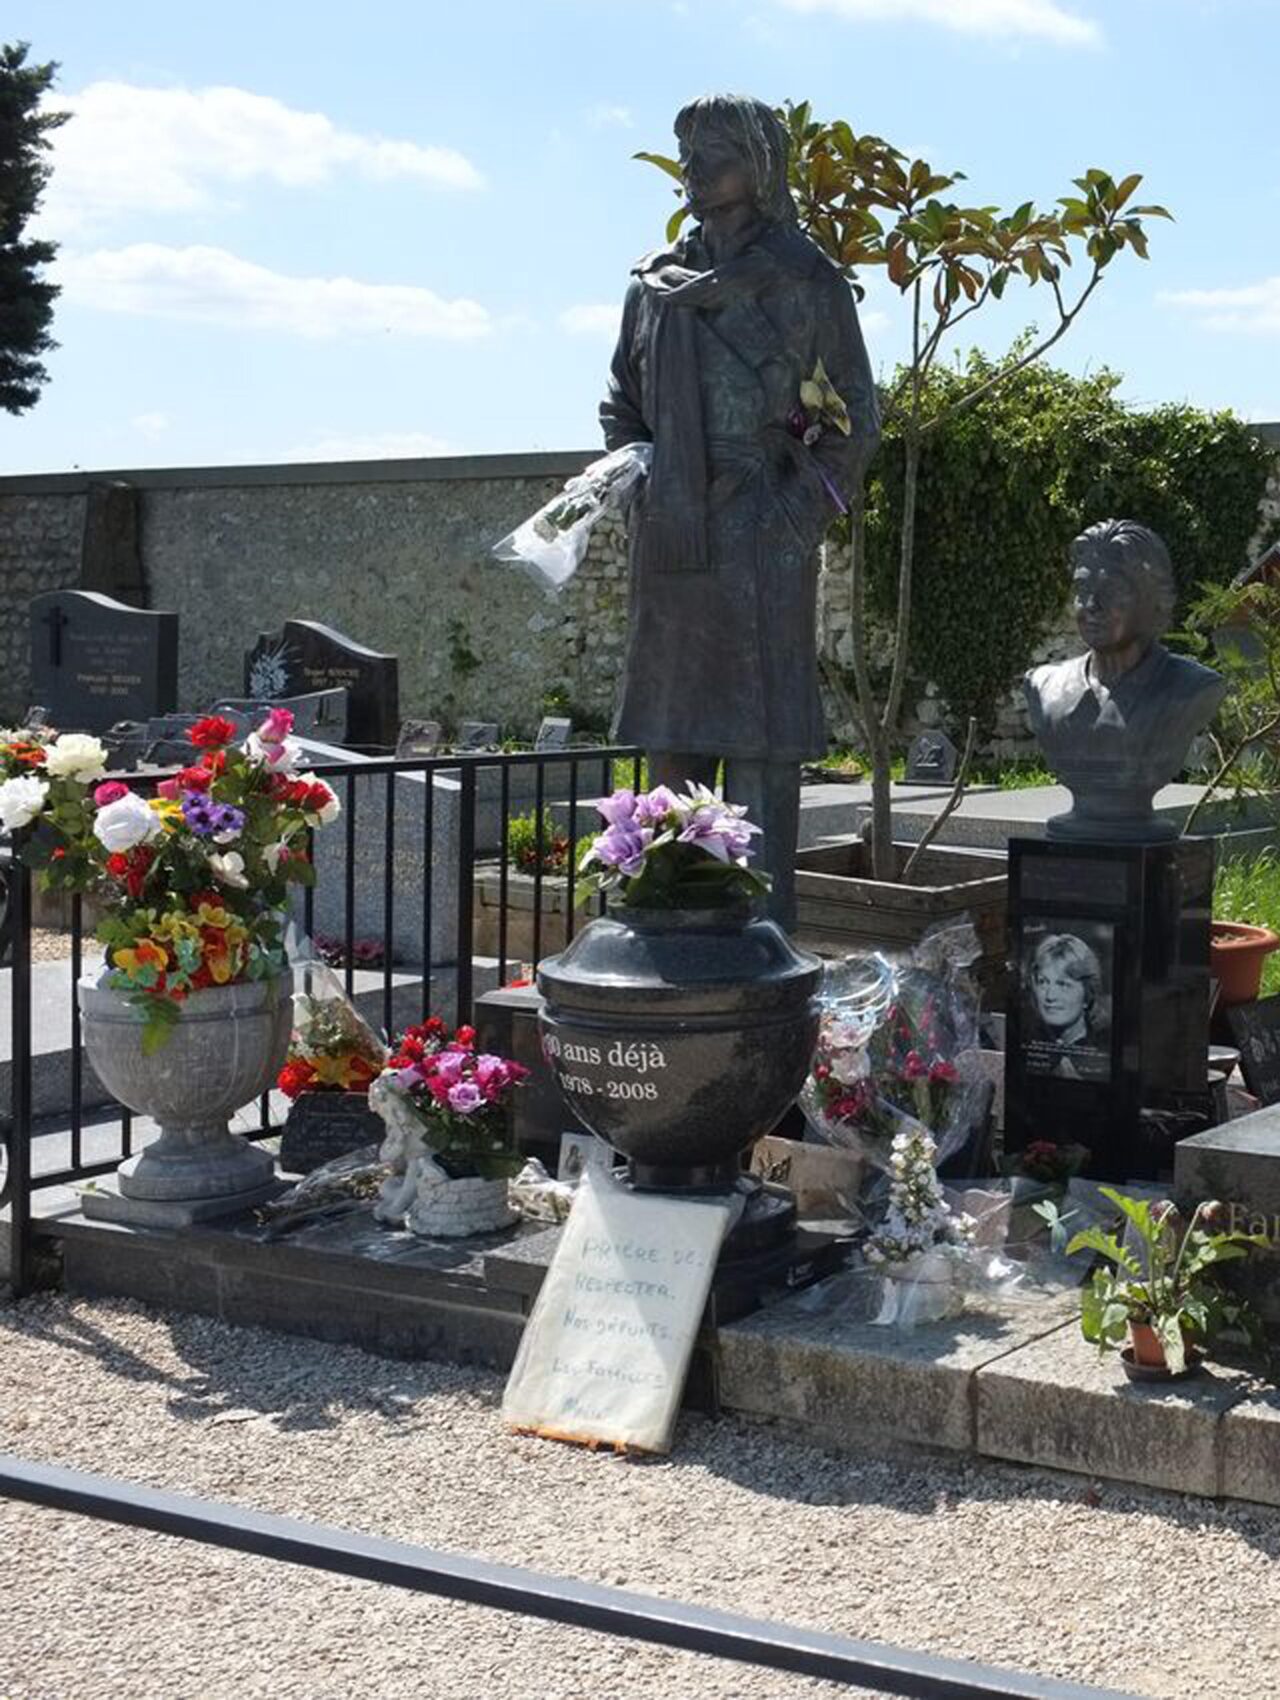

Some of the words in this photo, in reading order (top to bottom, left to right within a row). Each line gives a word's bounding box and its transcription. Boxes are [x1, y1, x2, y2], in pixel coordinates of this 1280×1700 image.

[563, 1042, 602, 1065] ans
[608, 1041, 667, 1074] déjà
[559, 1071, 594, 1096] 1978
[606, 1081, 659, 1100] 2008
